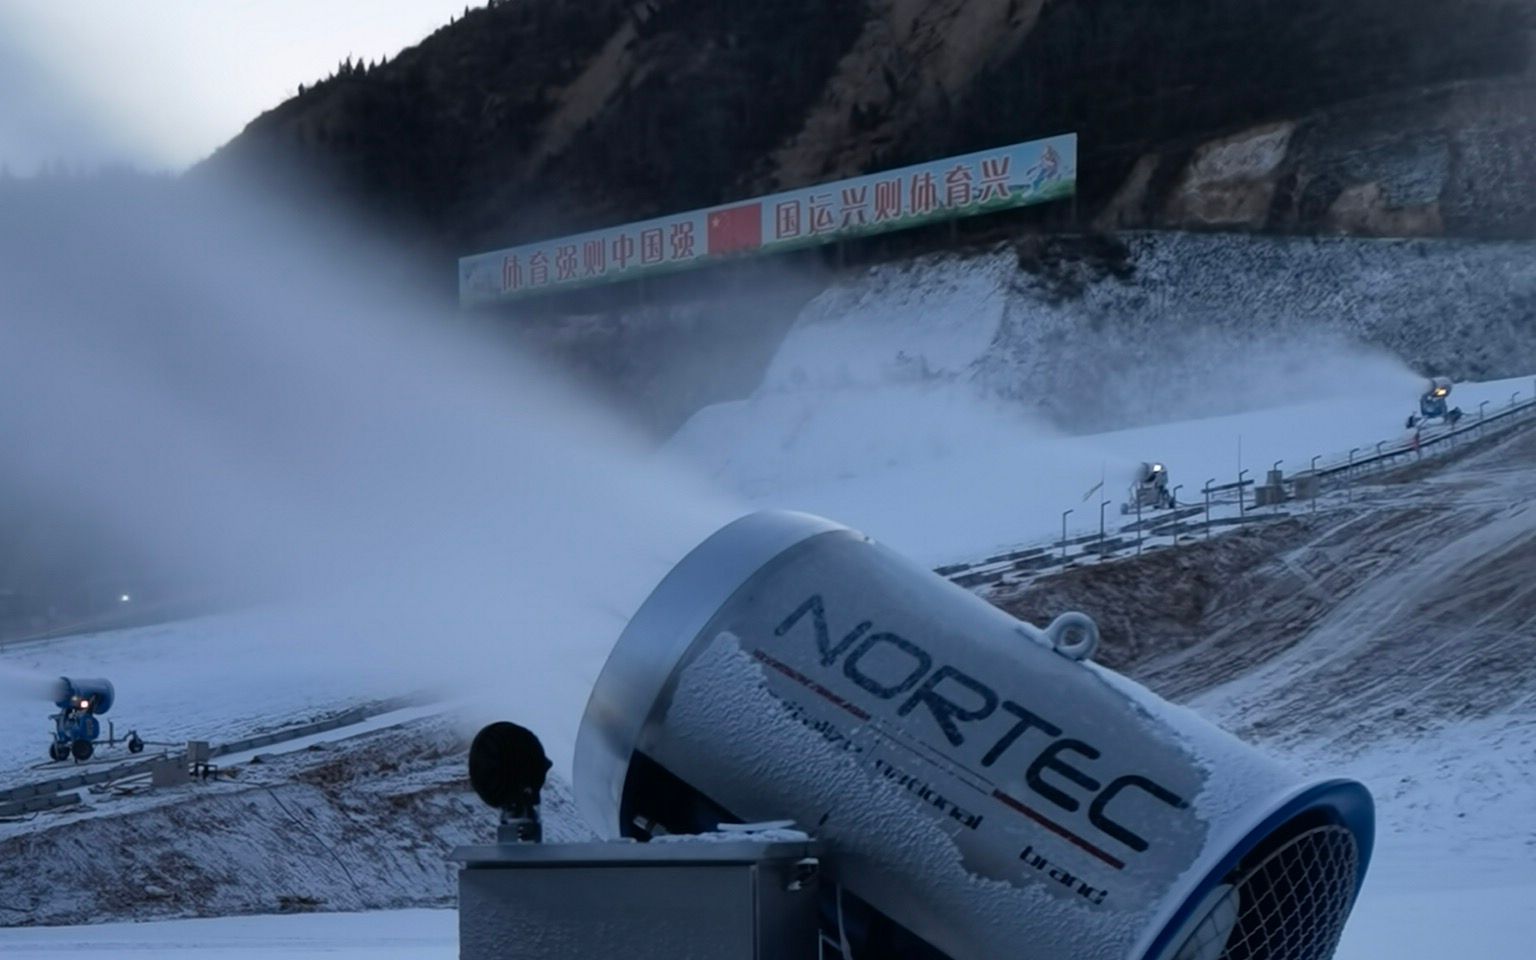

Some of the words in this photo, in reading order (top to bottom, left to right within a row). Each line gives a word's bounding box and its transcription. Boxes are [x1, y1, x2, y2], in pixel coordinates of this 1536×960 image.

[501, 220, 696, 293] 体育强则中国强
[775, 155, 1013, 241] 国运兴则体育兴
[774, 593, 1190, 853] NORTEC
[1018, 845, 1109, 905] brand
